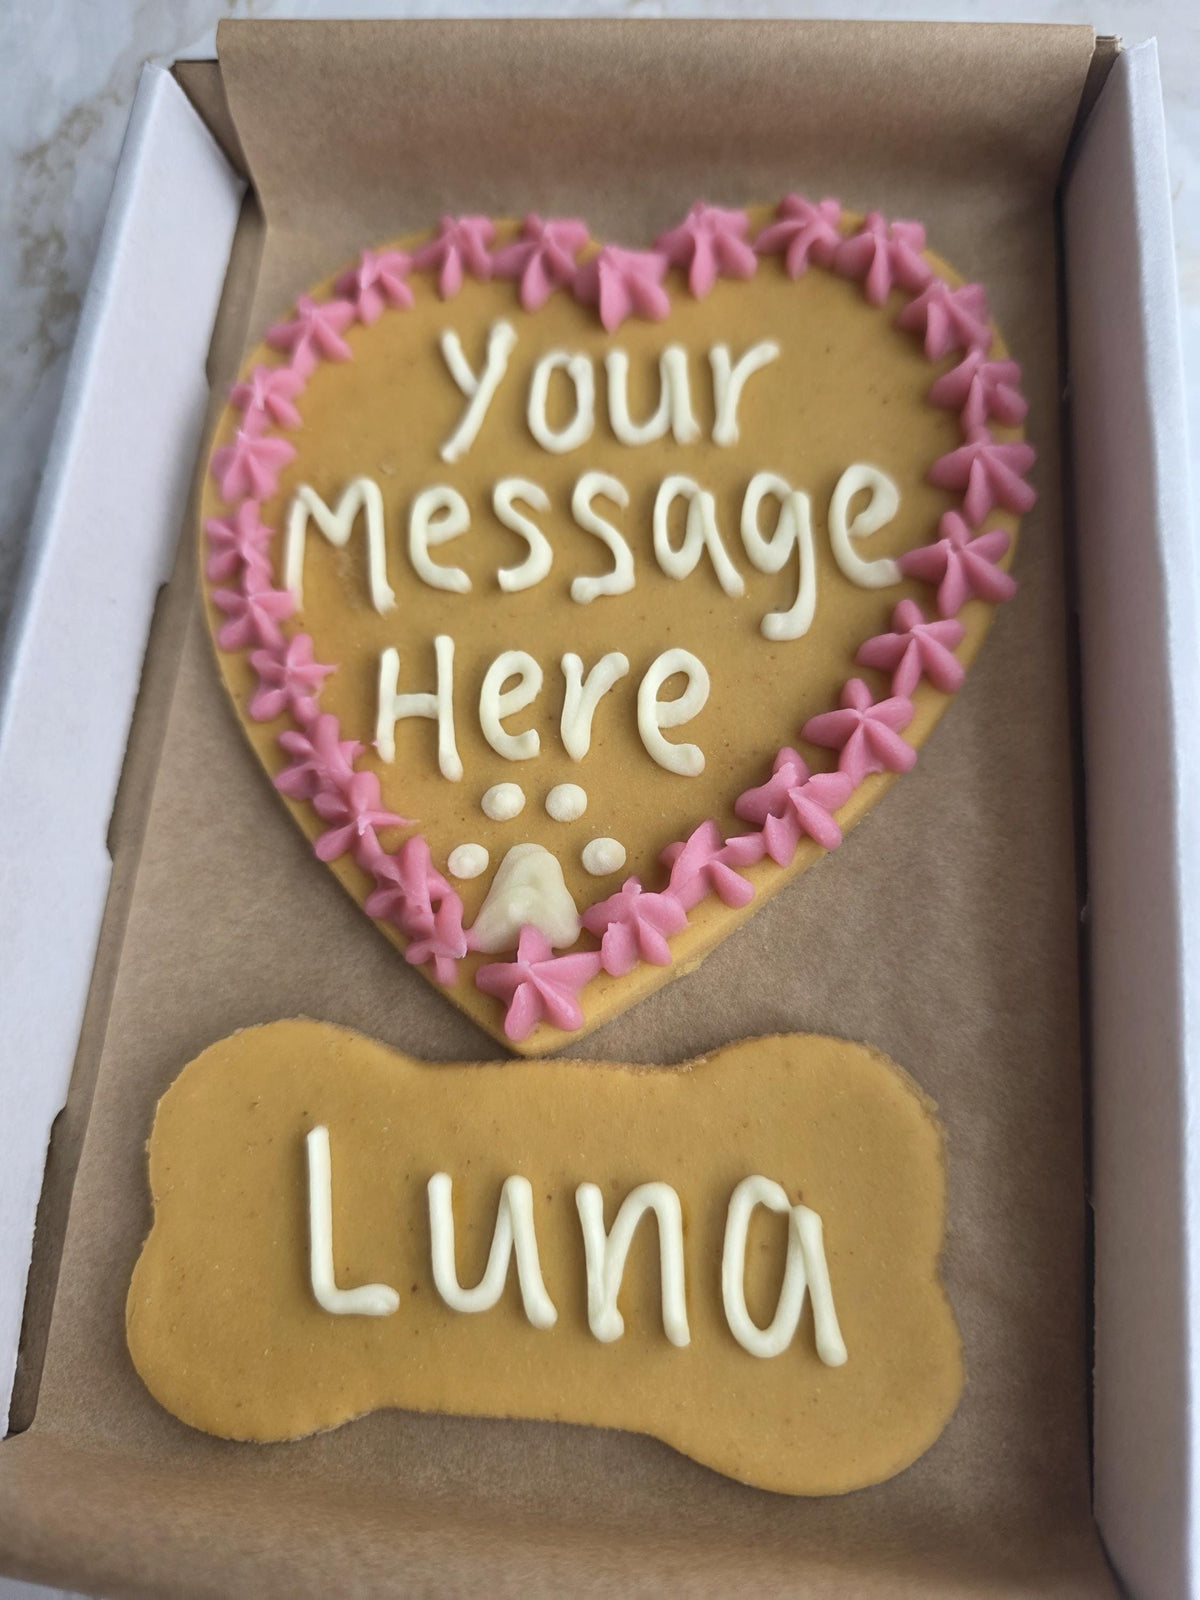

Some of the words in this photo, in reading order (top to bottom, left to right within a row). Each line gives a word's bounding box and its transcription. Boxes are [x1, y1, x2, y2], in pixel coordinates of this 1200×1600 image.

[284, 463, 902, 642] Message
[374, 634, 711, 782] Here
[306, 1124, 849, 1368] Luna
